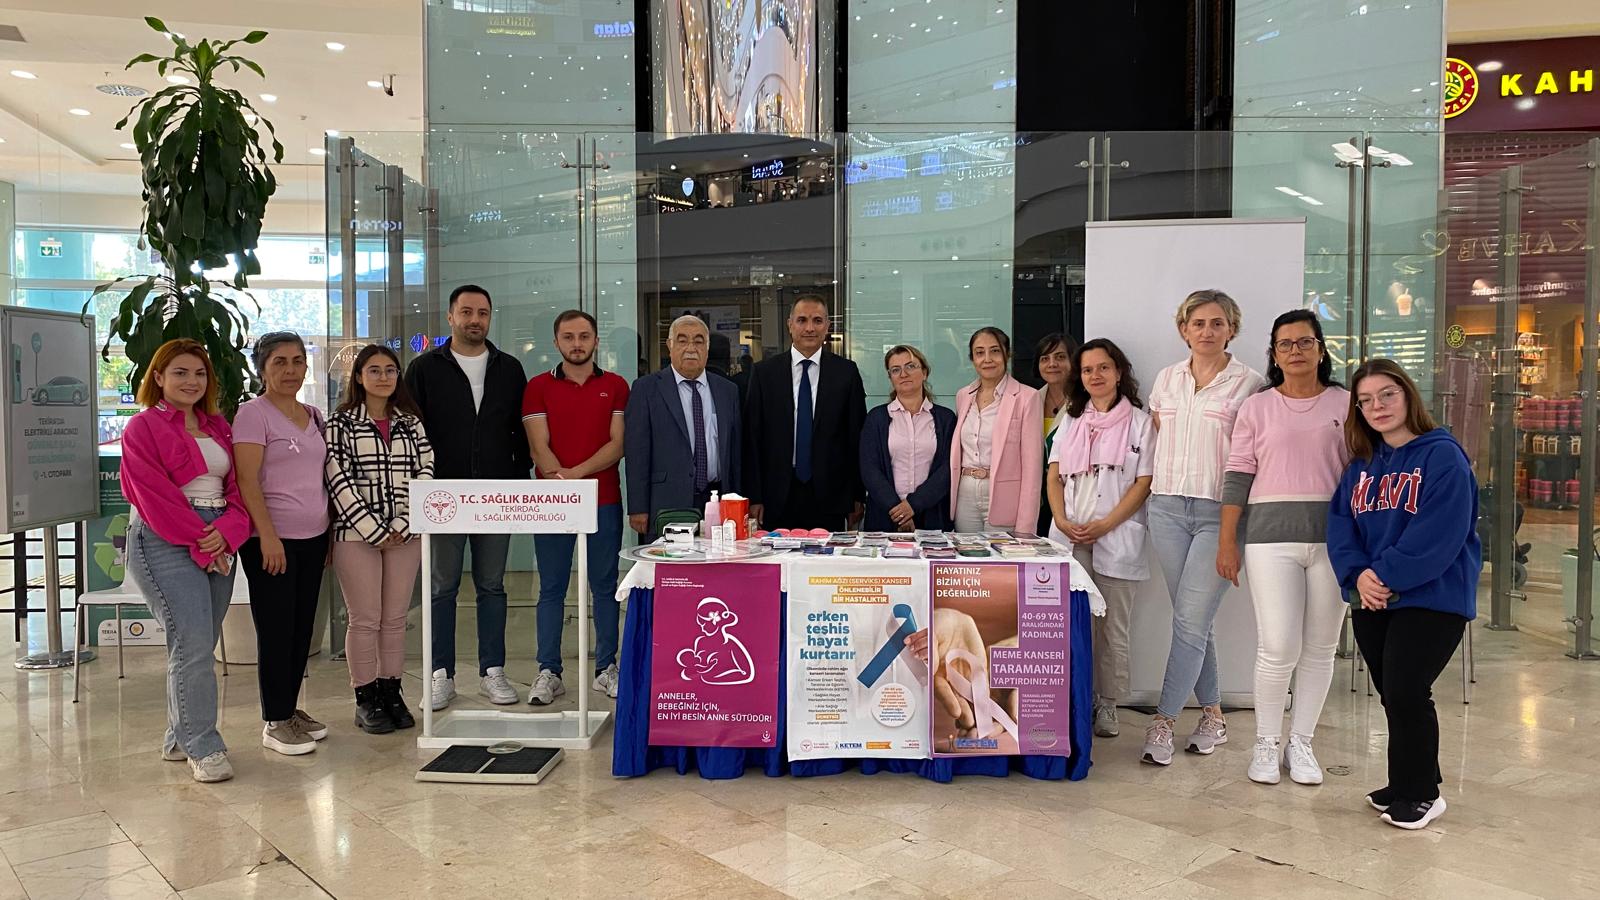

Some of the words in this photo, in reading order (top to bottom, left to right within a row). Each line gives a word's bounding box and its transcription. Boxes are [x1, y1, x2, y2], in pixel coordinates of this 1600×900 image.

[1501, 69, 1593, 97] KAH
[460, 494, 478, 504] T.C.
[481, 492, 520, 504] SAĞLIK
[521, 492, 581, 504] BAKANLIĞI
[500, 504, 540, 512] TEKİRDAĞ
[474, 513, 482, 522] İL
[483, 513, 512, 522] SAĞLIK
[512, 513, 566, 522] MÜDÜRLÜĞÜ
[936, 567, 981, 575] HAYATINIZ
[936, 578, 961, 586] BİZİM
[962, 578, 980, 588] İÇİN
[936, 589, 990, 598] DEĞERLİDİR!
[808, 611, 848, 622] erken
[1048, 612, 1064, 622] YAŞ
[806, 623, 850, 636] teşhis
[808, 636, 848, 648] hayat
[800, 648, 856, 660] kurtarır
[993, 650, 1022, 659] MEME
[1024, 650, 1064, 660] KANSERİ
[992, 664, 1064, 674] TARAMANIZI
[993, 678, 1048, 686] YAPTIRDINIZ
[658, 692, 698, 701] ANNELER,
[658, 702, 700, 710] BEBEĞİNİZ
[702, 702, 720, 712] İÇİN,
[731, 714, 772, 722] SÜTÜDÜR!
